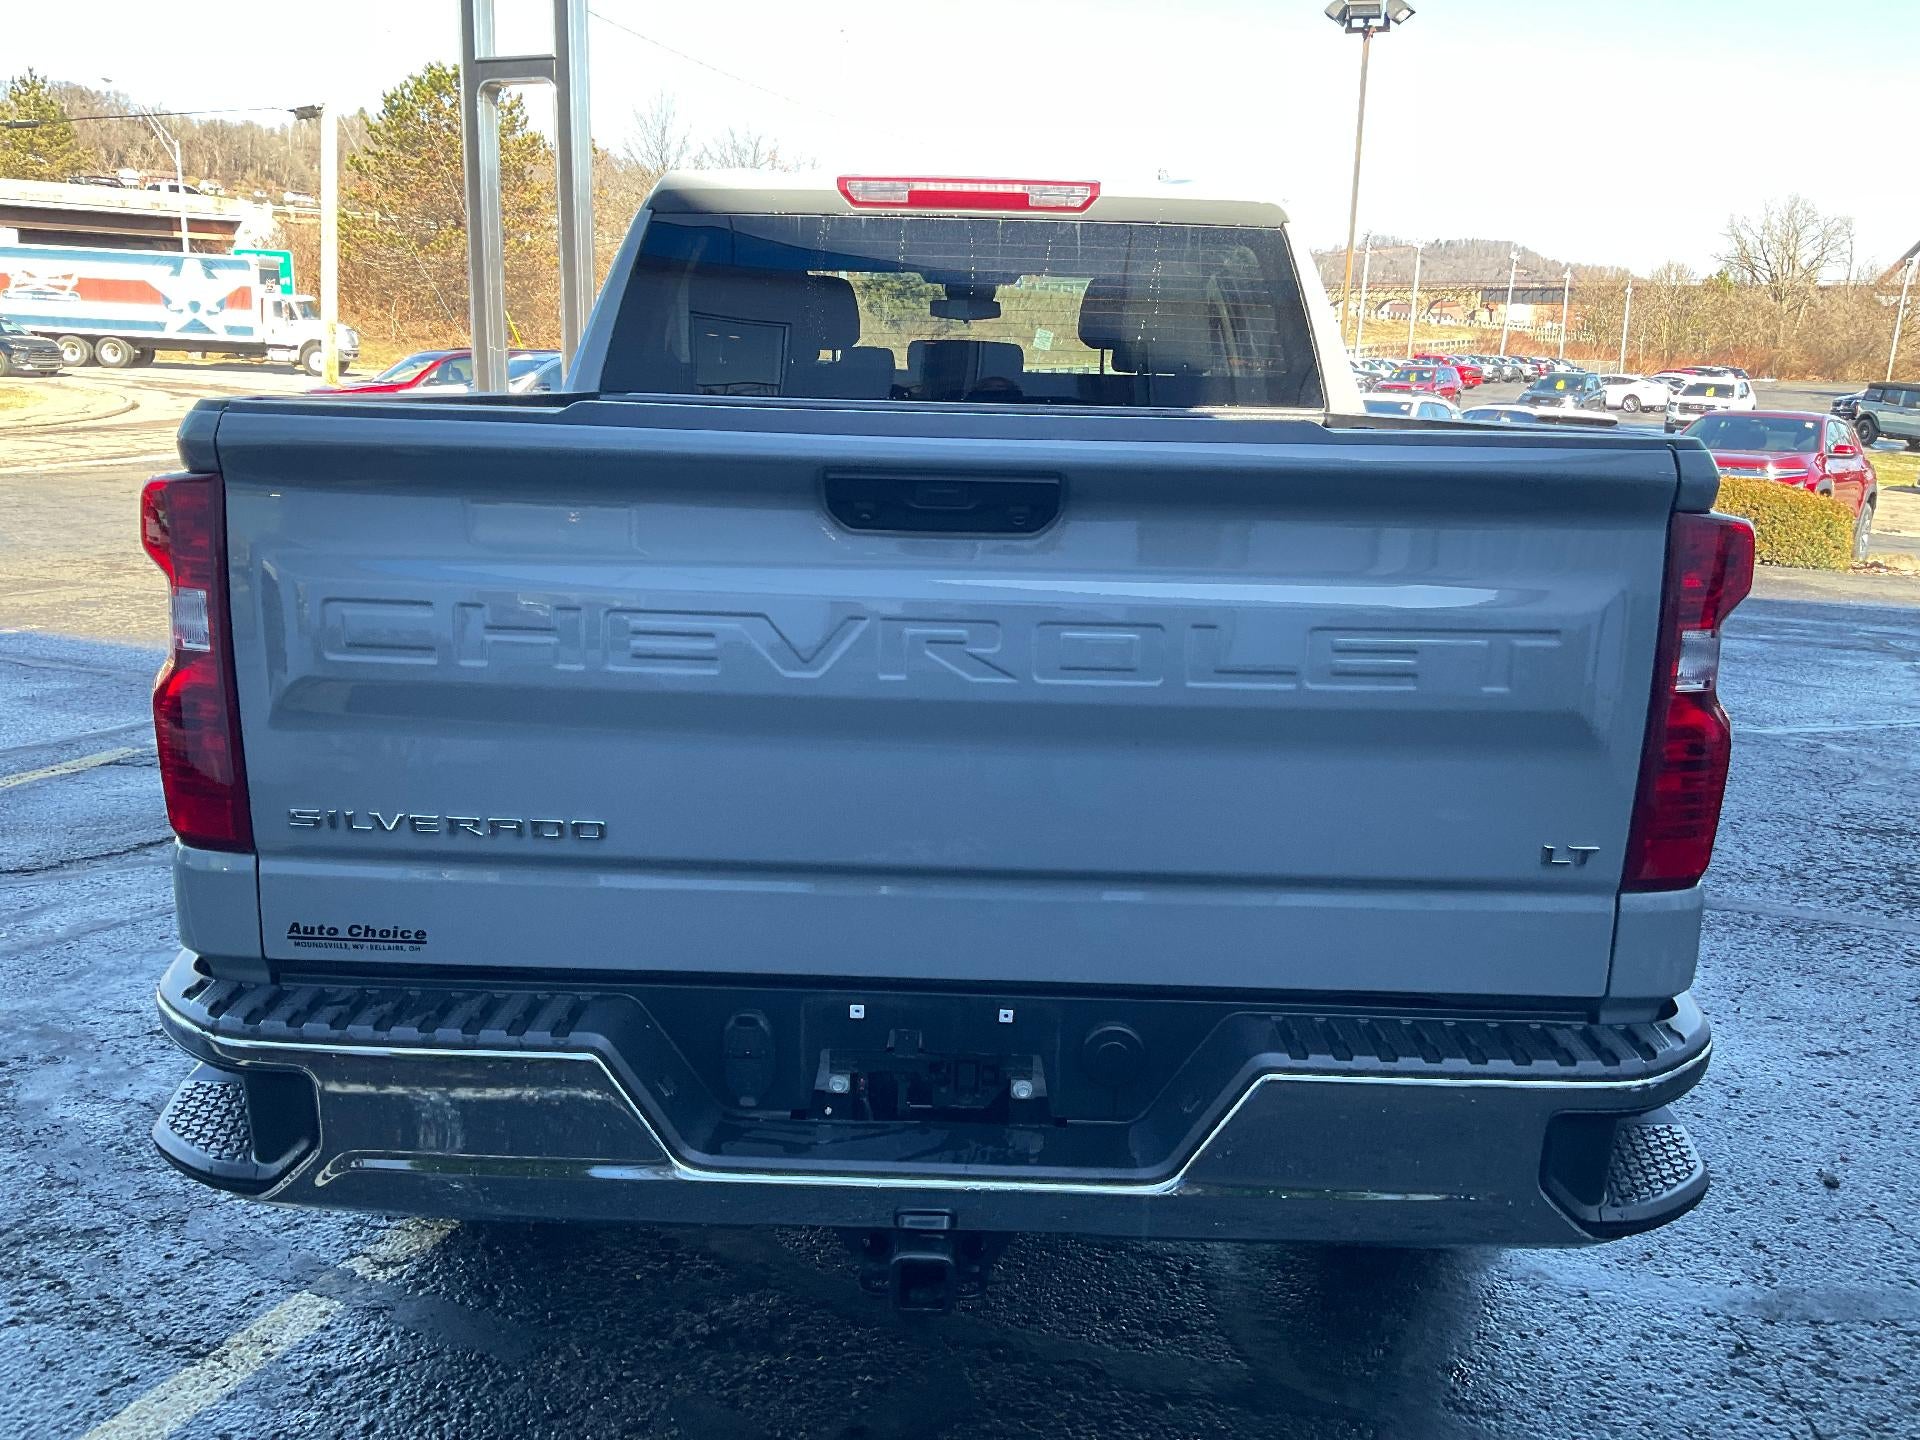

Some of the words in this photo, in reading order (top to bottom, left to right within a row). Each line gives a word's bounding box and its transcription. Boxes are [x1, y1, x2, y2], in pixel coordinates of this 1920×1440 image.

[322, 597, 1564, 694] CHEVROLET
[288, 808, 607, 840] SILVERADO
[1541, 845, 1600, 866] LT
[287, 922, 339, 936] Auto
[347, 924, 427, 940] Choice
